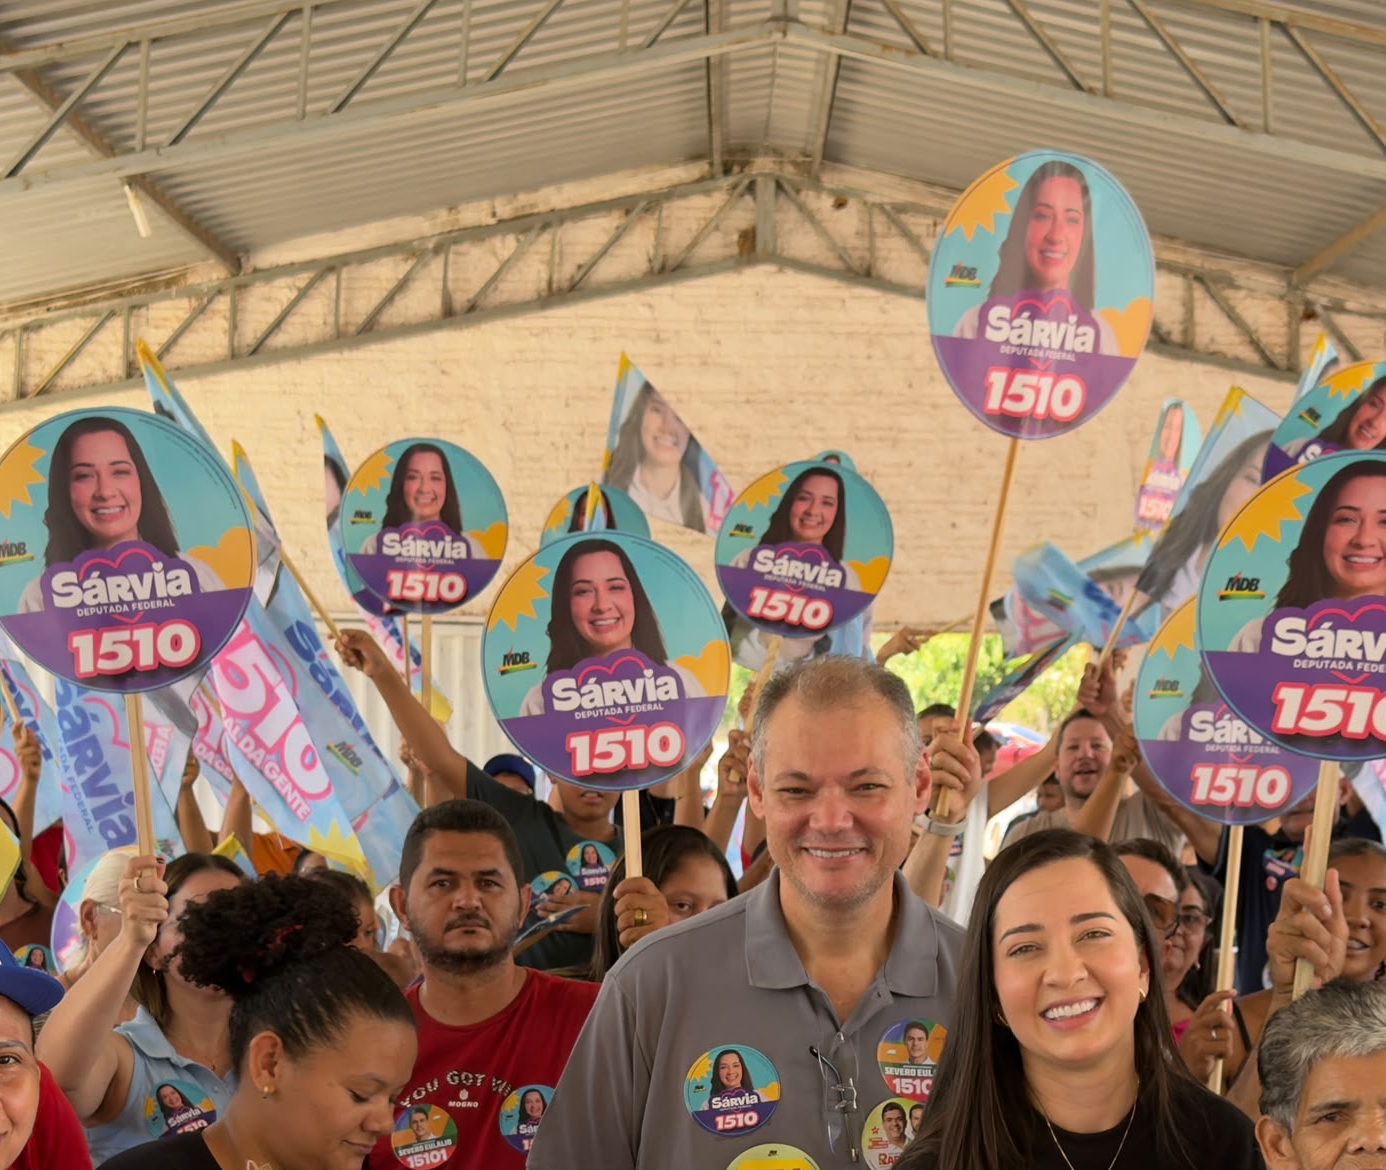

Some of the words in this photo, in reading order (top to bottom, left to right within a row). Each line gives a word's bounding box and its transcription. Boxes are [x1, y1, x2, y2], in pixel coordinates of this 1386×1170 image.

[985, 305, 1095, 354] Sárvia
[1000, 345, 1043, 357] DEPUTADA
[1044, 350, 1076, 361] FEDERAL
[987, 371, 1083, 418] 1510
[382, 532, 467, 558] Sárvia
[752, 549, 843, 588] Sárvia
[51, 561, 192, 609] Sárvia
[388, 572, 463, 599] 1510
[77, 604, 129, 617] DEPUTADA
[132, 599, 175, 613] FEDERAL
[749, 588, 831, 628] 1510
[71, 626, 197, 675] 1510
[1293, 659, 1353, 672] DEPUTADA
[552, 669, 679, 712] Sárvia
[574, 706, 622, 720] DEPUTADA
[625, 703, 664, 715] FEDERAL
[569, 726, 682, 773] 1510
[1205, 743, 1241, 753] DEPUTADA
[263, 759, 313, 823] GENTE
[1193, 766, 1288, 805] 1510
[446, 1070, 486, 1087] GOT
[884, 1066, 916, 1077] SEVERO
[892, 1078, 933, 1095] 1510
[711, 1091, 758, 1112] Sárvia
[714, 1111, 759, 1131] 1510
[398, 1144, 424, 1157] SEVERO
[407, 1149, 448, 1169] 15101
